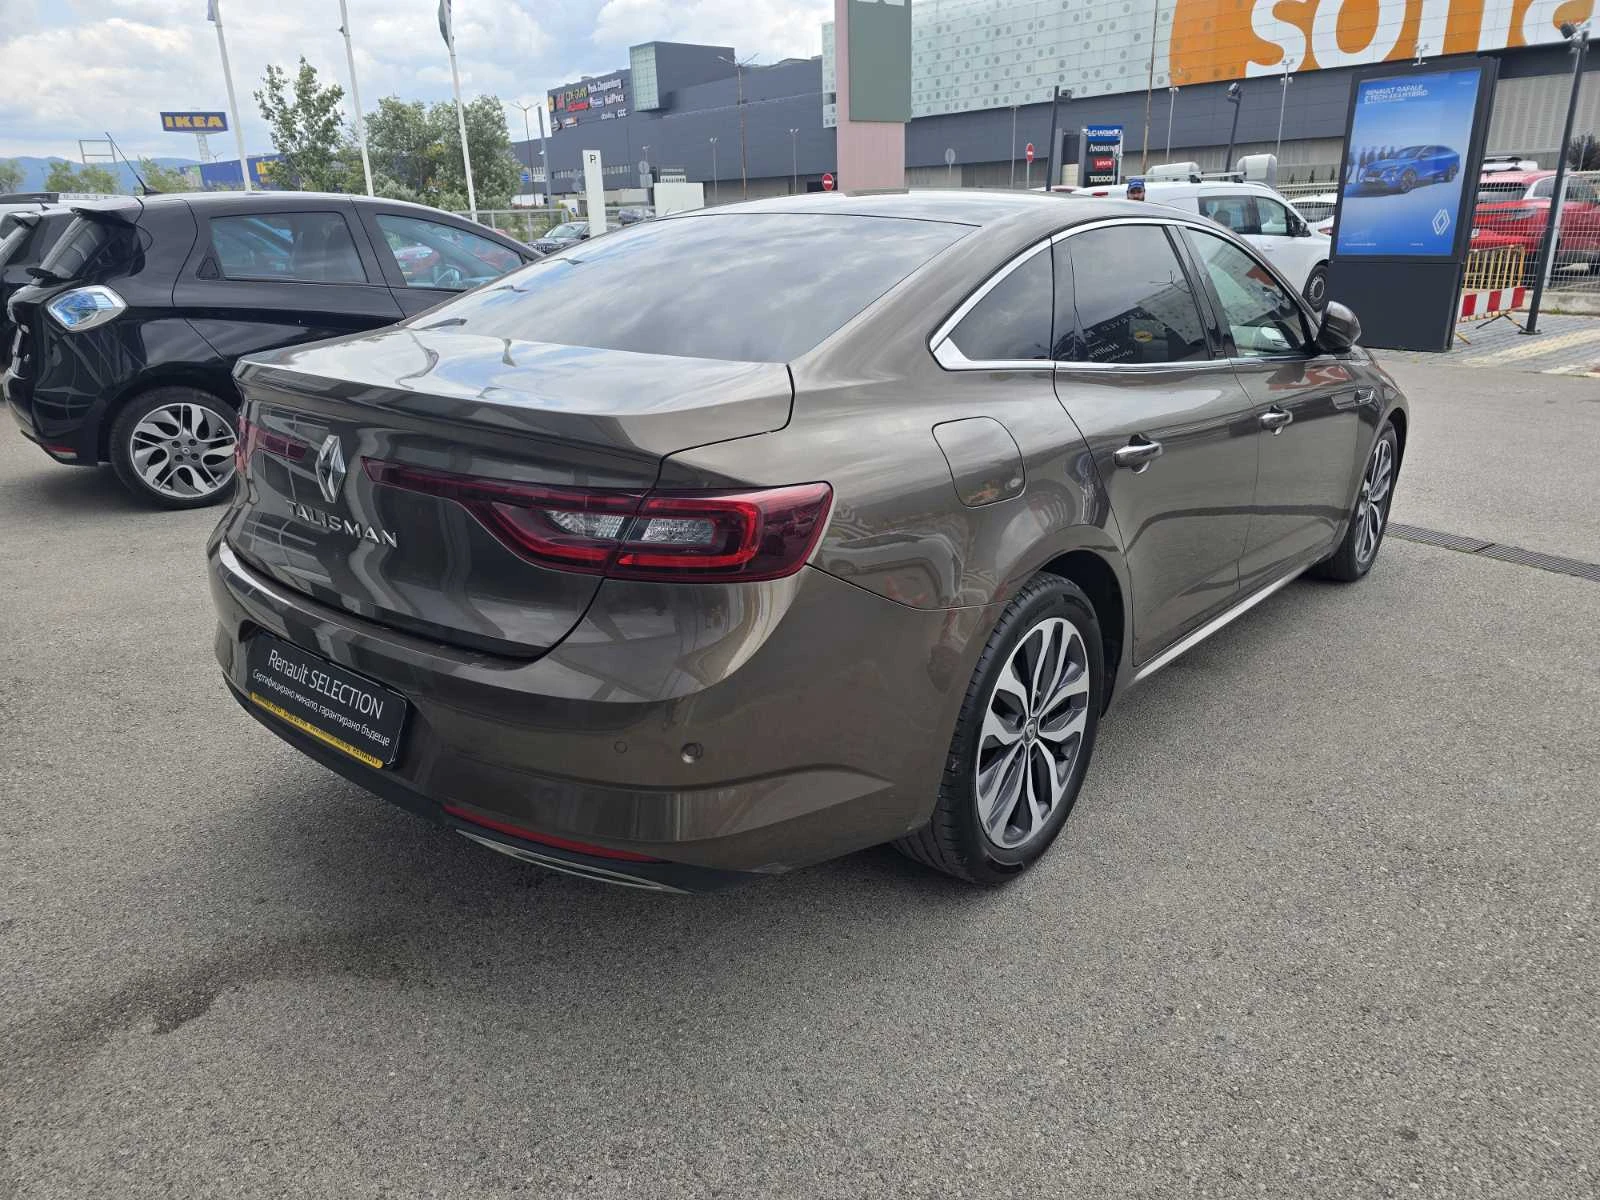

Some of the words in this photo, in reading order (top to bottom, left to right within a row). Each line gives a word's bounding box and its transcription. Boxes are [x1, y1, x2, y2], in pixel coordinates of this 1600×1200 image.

[164, 116, 224, 128] IKEA
[589, 154, 597, 164] P
[286, 499, 398, 549] TALISMAN
[268, 649, 309, 685] Renault
[309, 670, 384, 720] SELECTION
[295, 693, 319, 715] минало,
[318, 704, 360, 731] гарантирано
[361, 723, 390, 749] бъдеще
